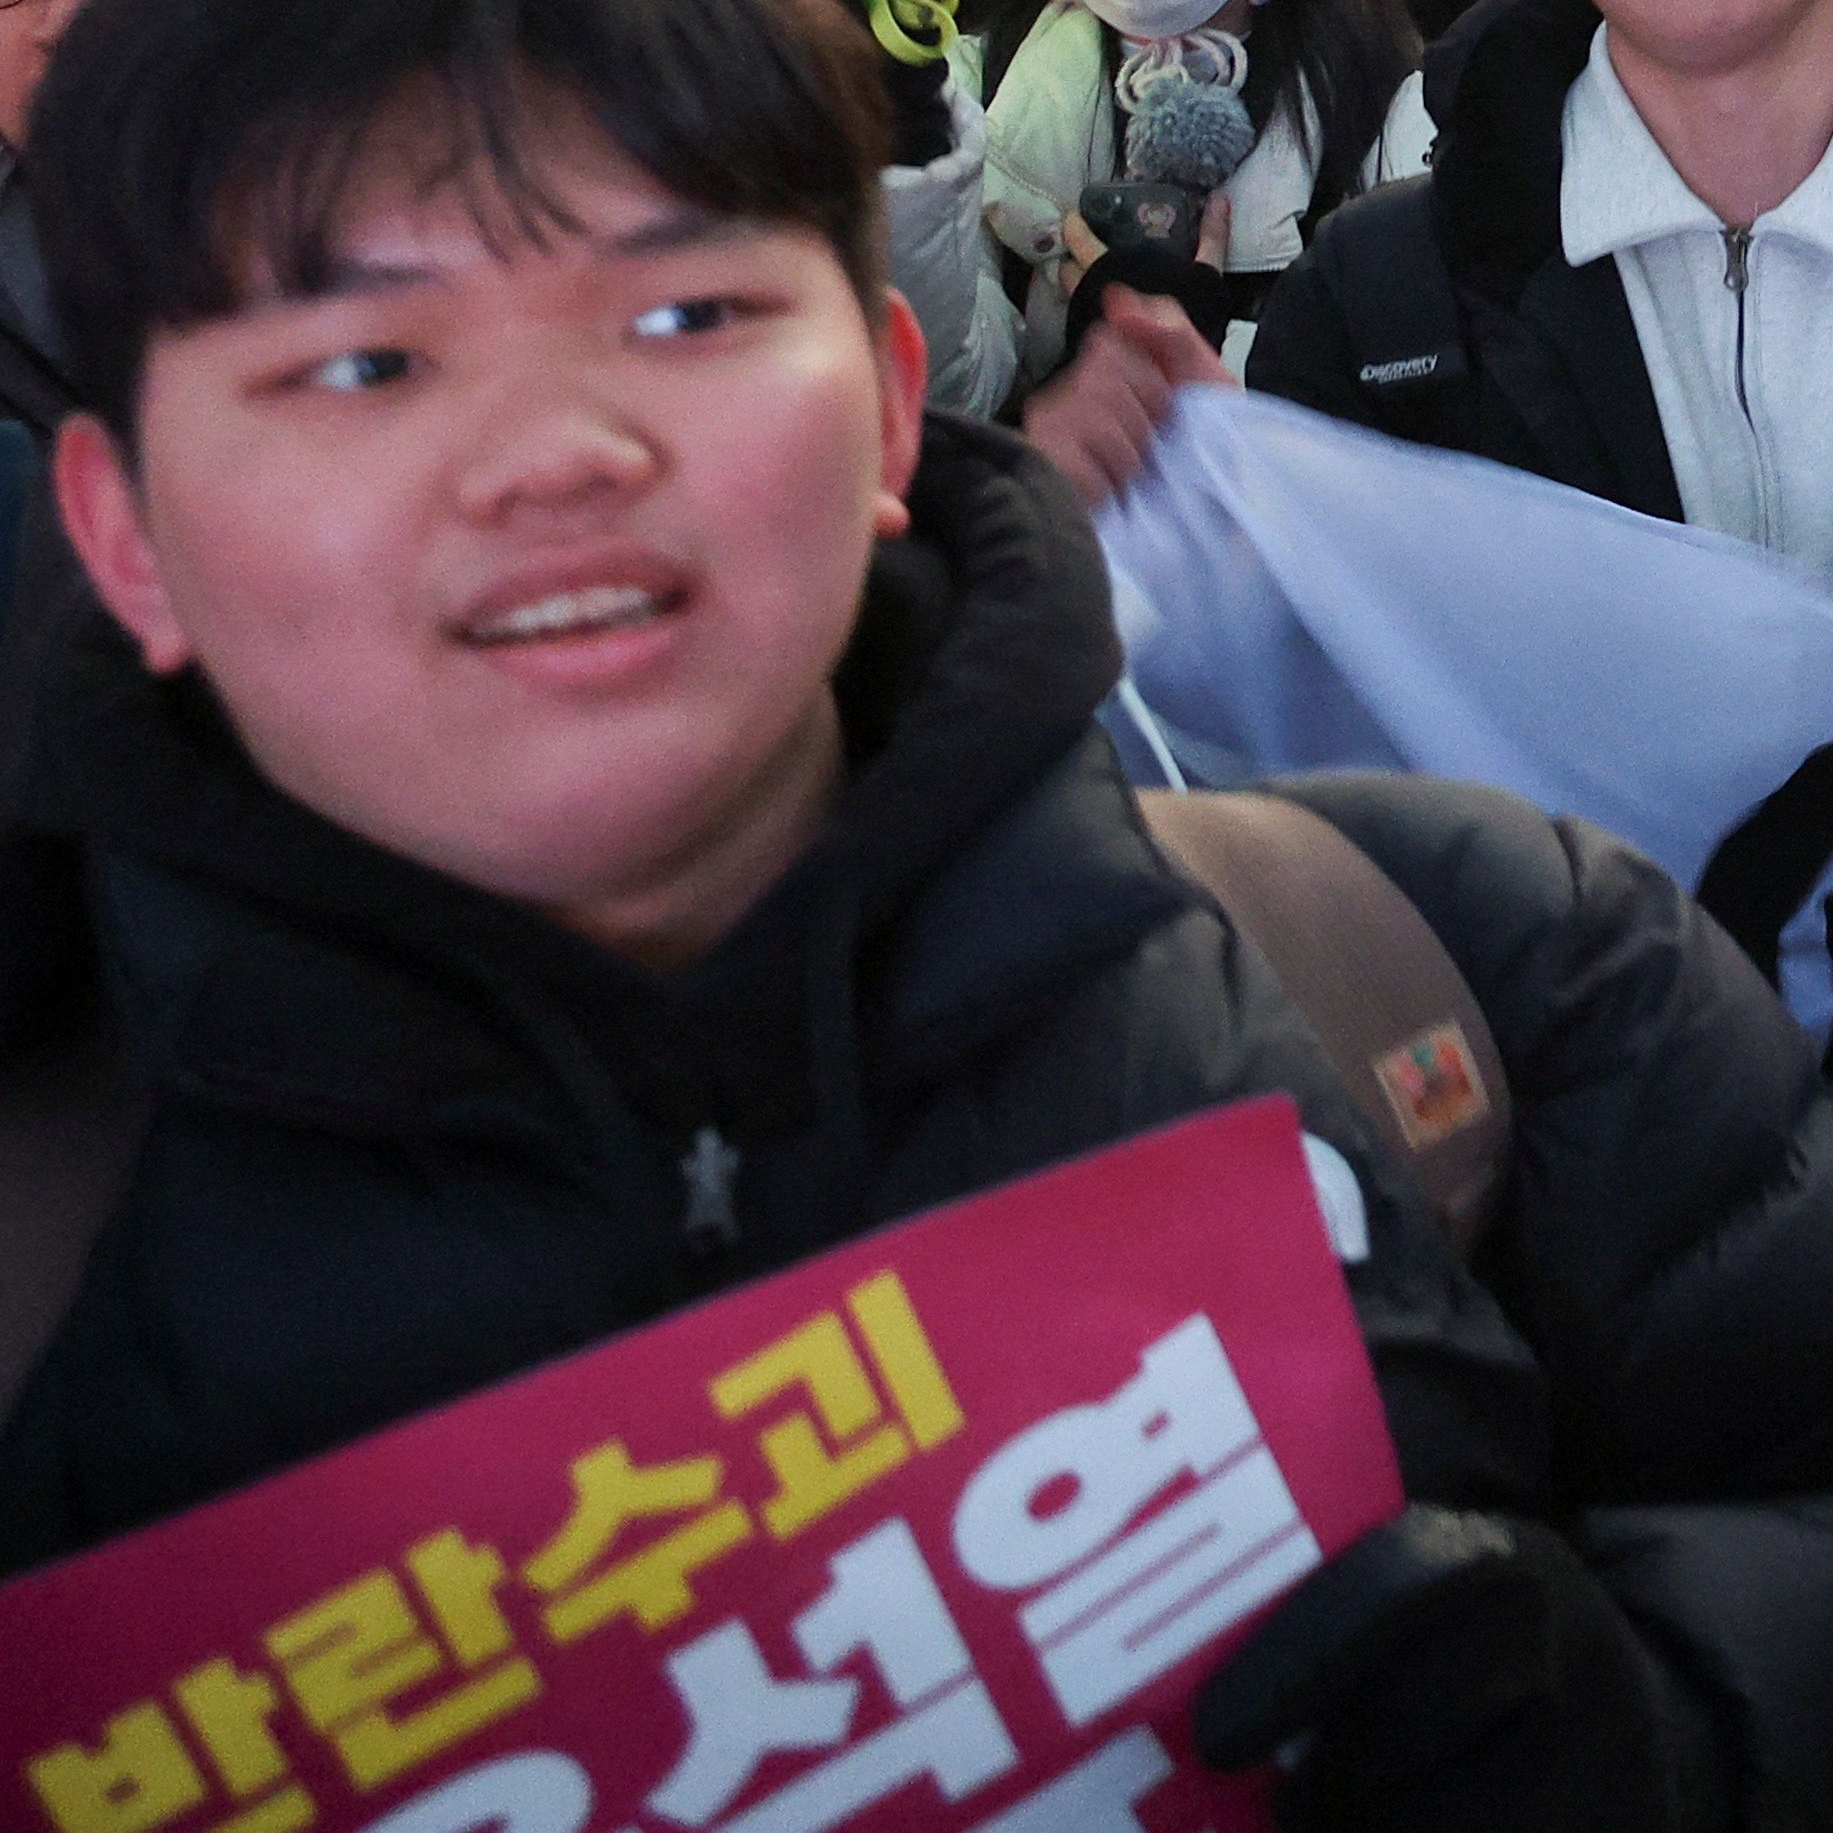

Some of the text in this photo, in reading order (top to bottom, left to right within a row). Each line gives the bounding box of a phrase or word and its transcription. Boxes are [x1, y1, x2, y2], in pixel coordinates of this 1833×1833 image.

[1359, 354, 1439, 382] Discovery
[30, 1269, 965, 1833] 반란수괴
[355, 1311, 1326, 1833] 석열
